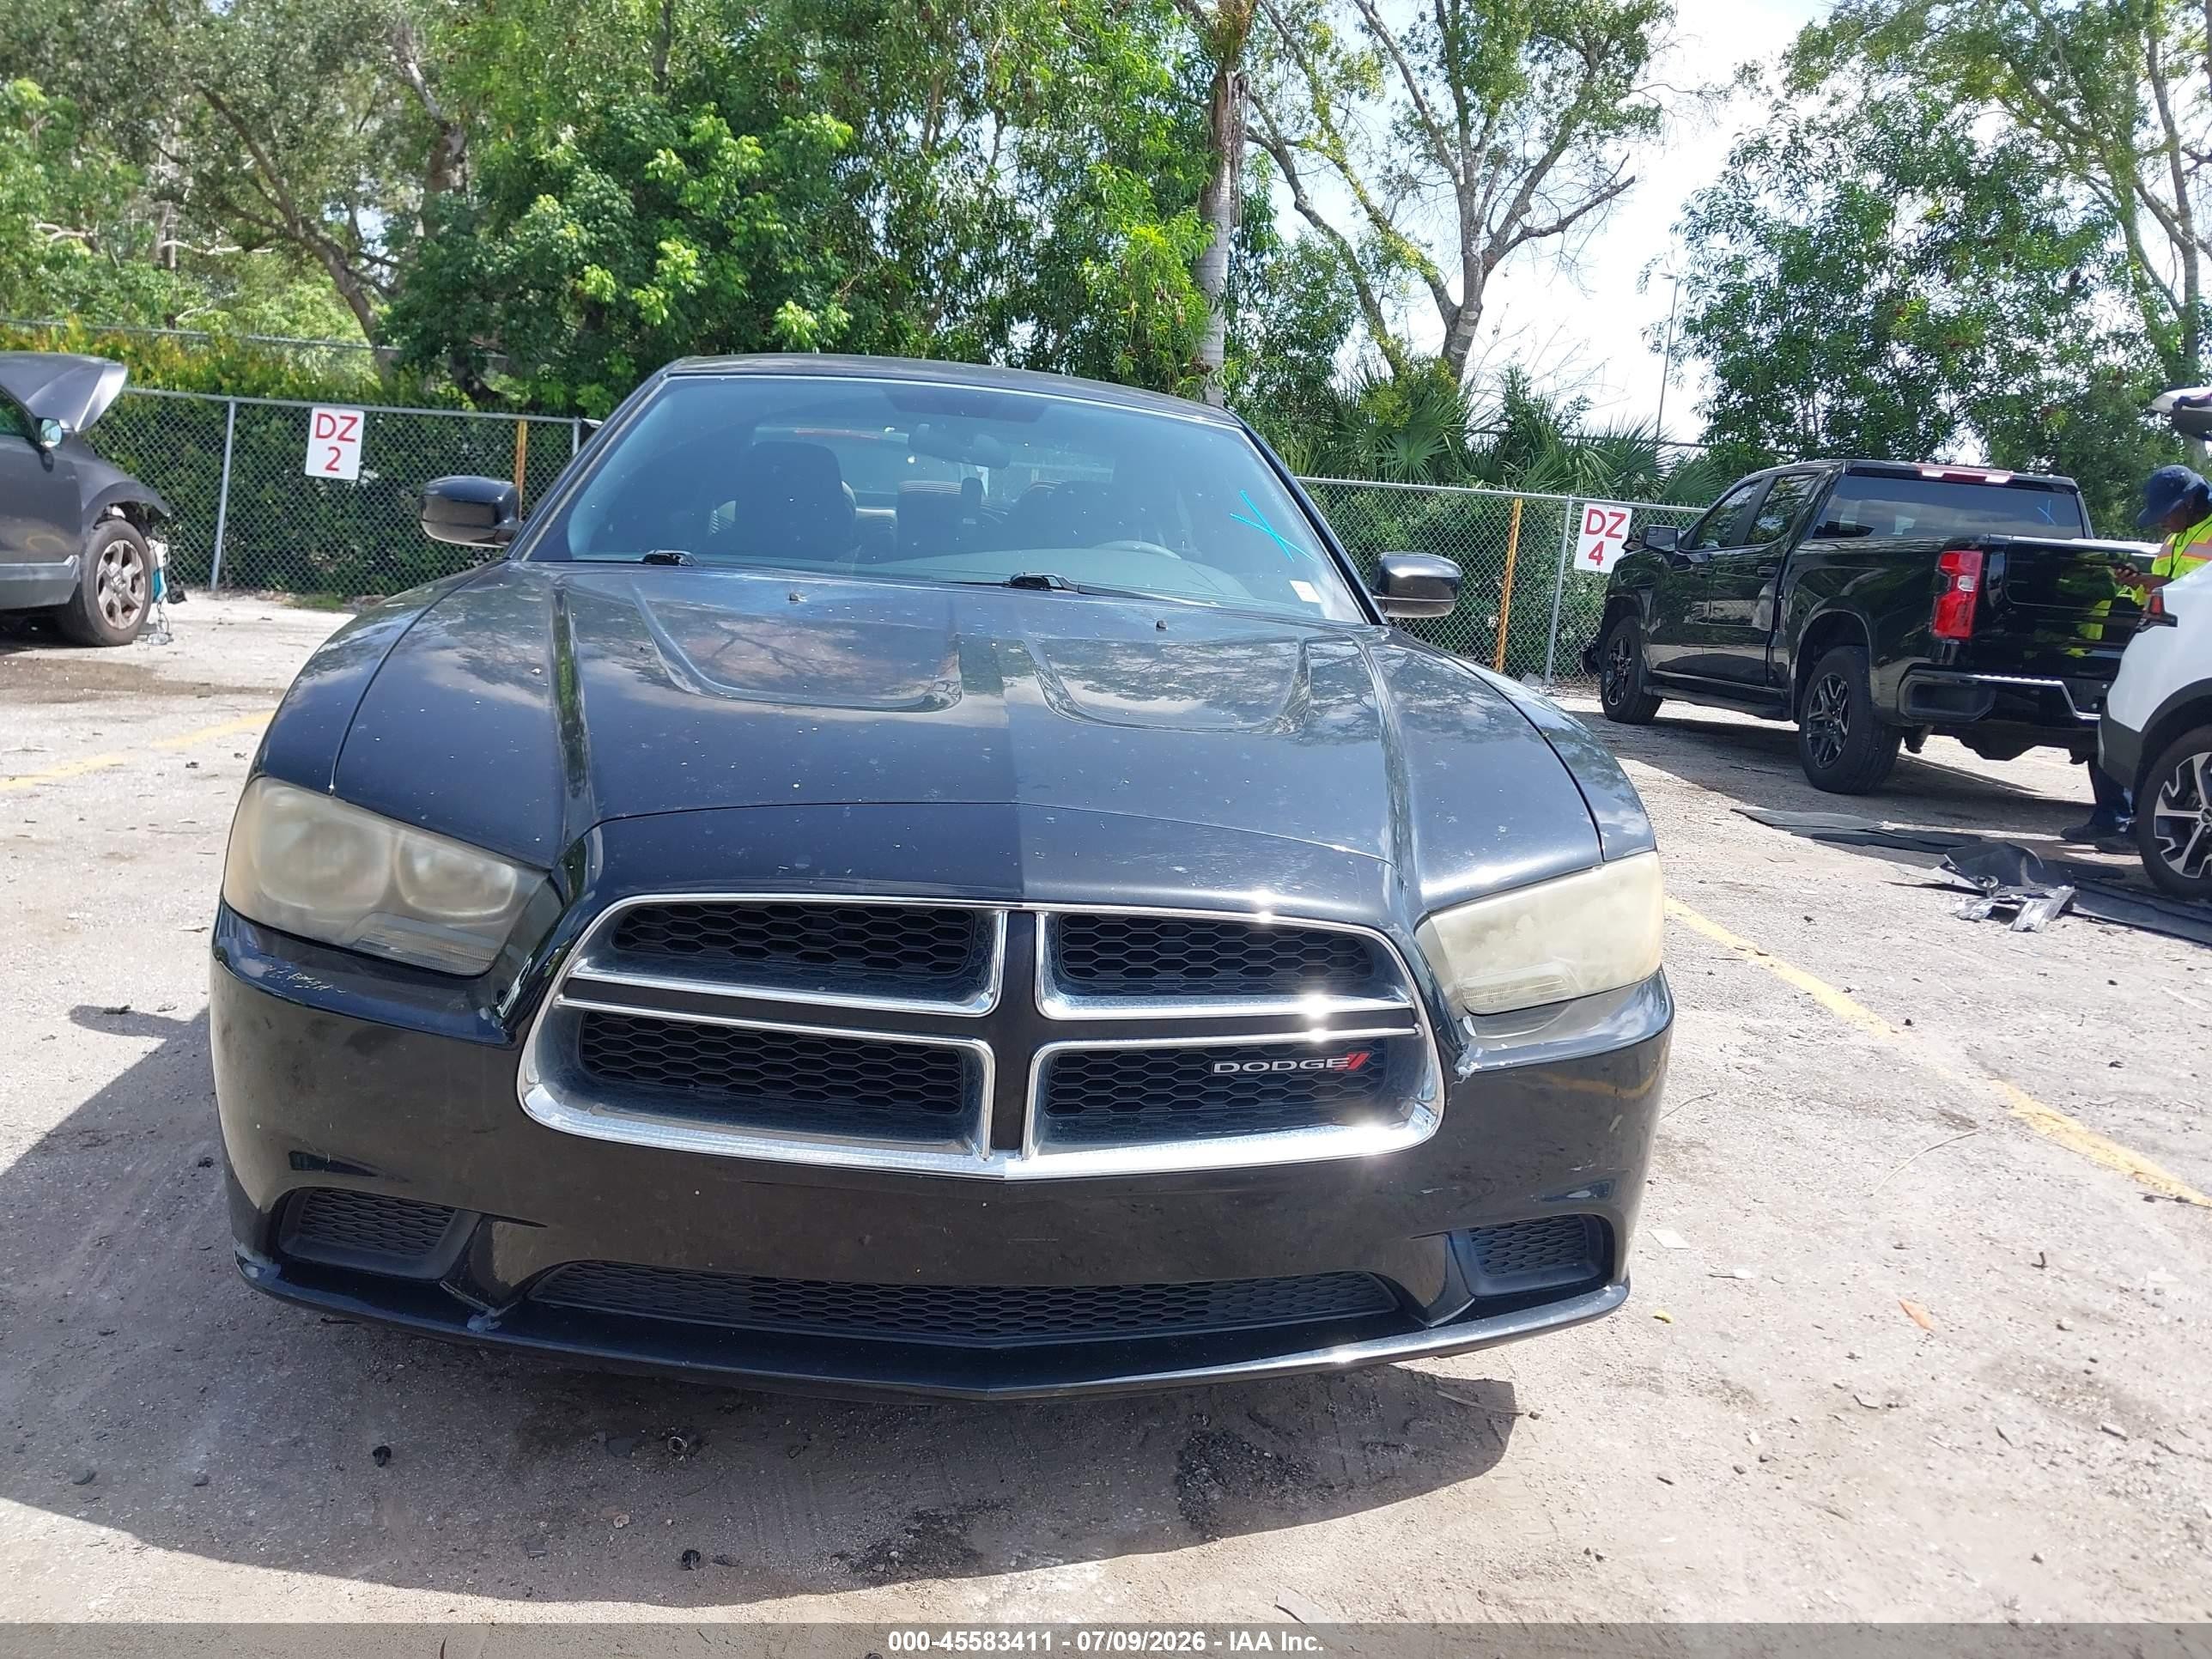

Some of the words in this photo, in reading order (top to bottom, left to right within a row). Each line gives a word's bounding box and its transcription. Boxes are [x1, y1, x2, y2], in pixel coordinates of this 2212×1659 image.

[315, 413, 358, 442] DZ
[325, 446, 342, 471] 2
[1584, 508, 1627, 539] DZ
[1588, 540, 1605, 566] 4
[1213, 1057, 1350, 1073] DODGE
